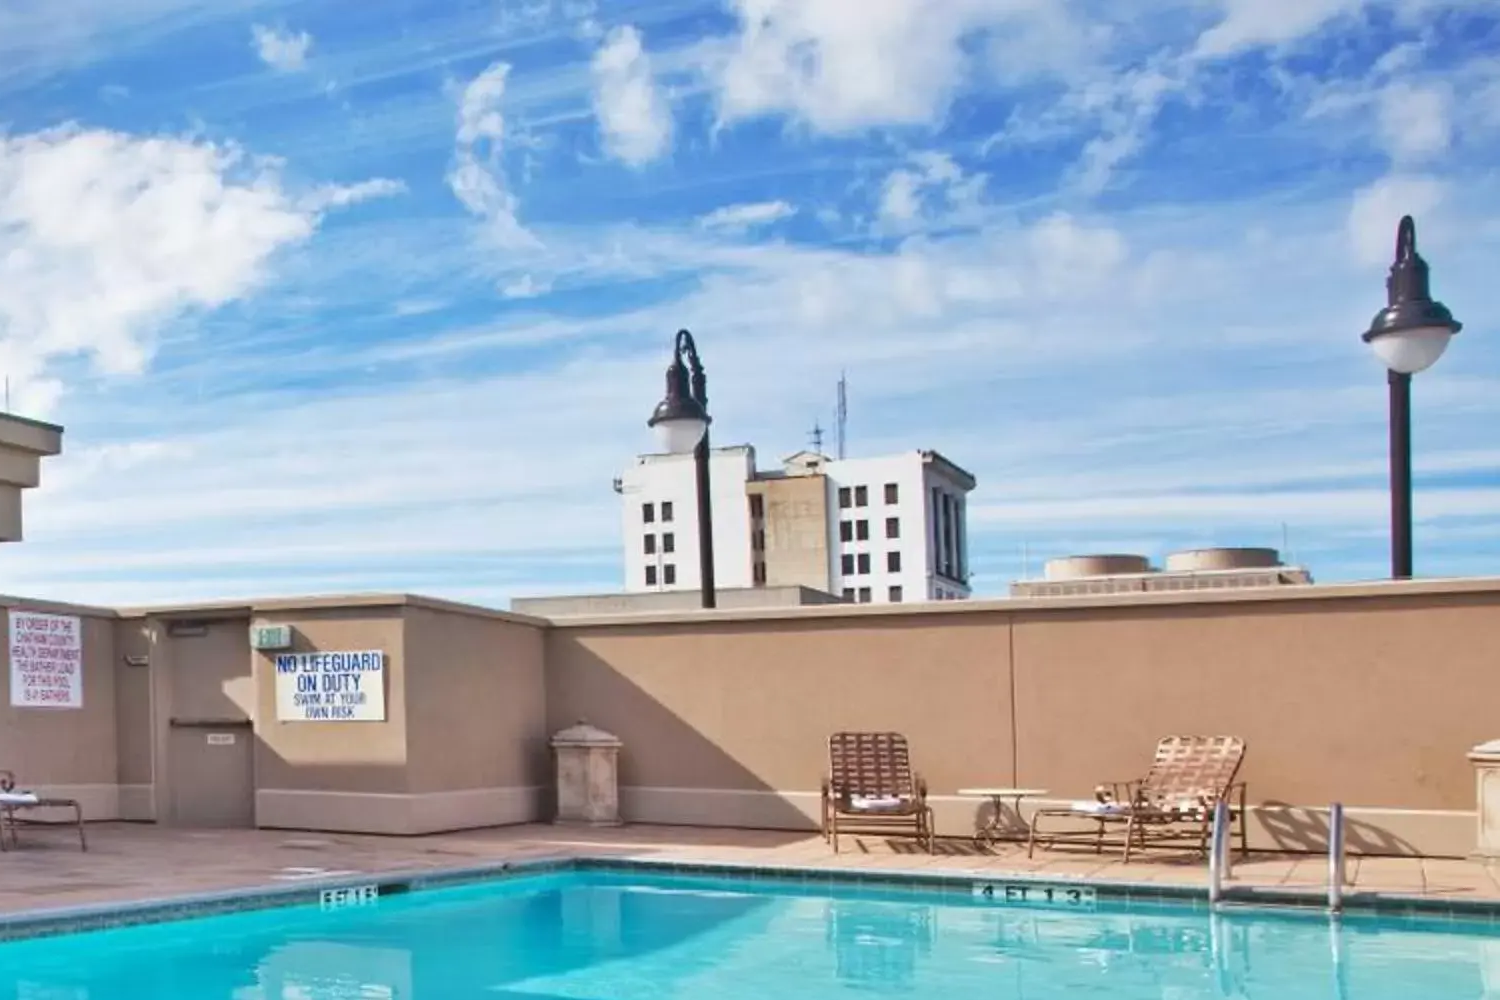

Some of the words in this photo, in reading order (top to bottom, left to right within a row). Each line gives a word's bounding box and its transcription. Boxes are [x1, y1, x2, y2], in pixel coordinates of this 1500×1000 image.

[258, 627, 282, 647] EXIT
[38, 646, 80, 660] DEPARTMENT
[277, 655, 297, 673] NO
[302, 652, 381, 673] LIFEGUARD
[297, 673, 317, 692] ON
[322, 673, 362, 692] DUTY
[293, 692, 321, 706] SWIM
[325, 692, 336, 705] AT
[340, 691, 367, 705] YOUR
[305, 705, 329, 718] OWN
[331, 705, 355, 718] RISK
[1005, 885, 1031, 902] FT
